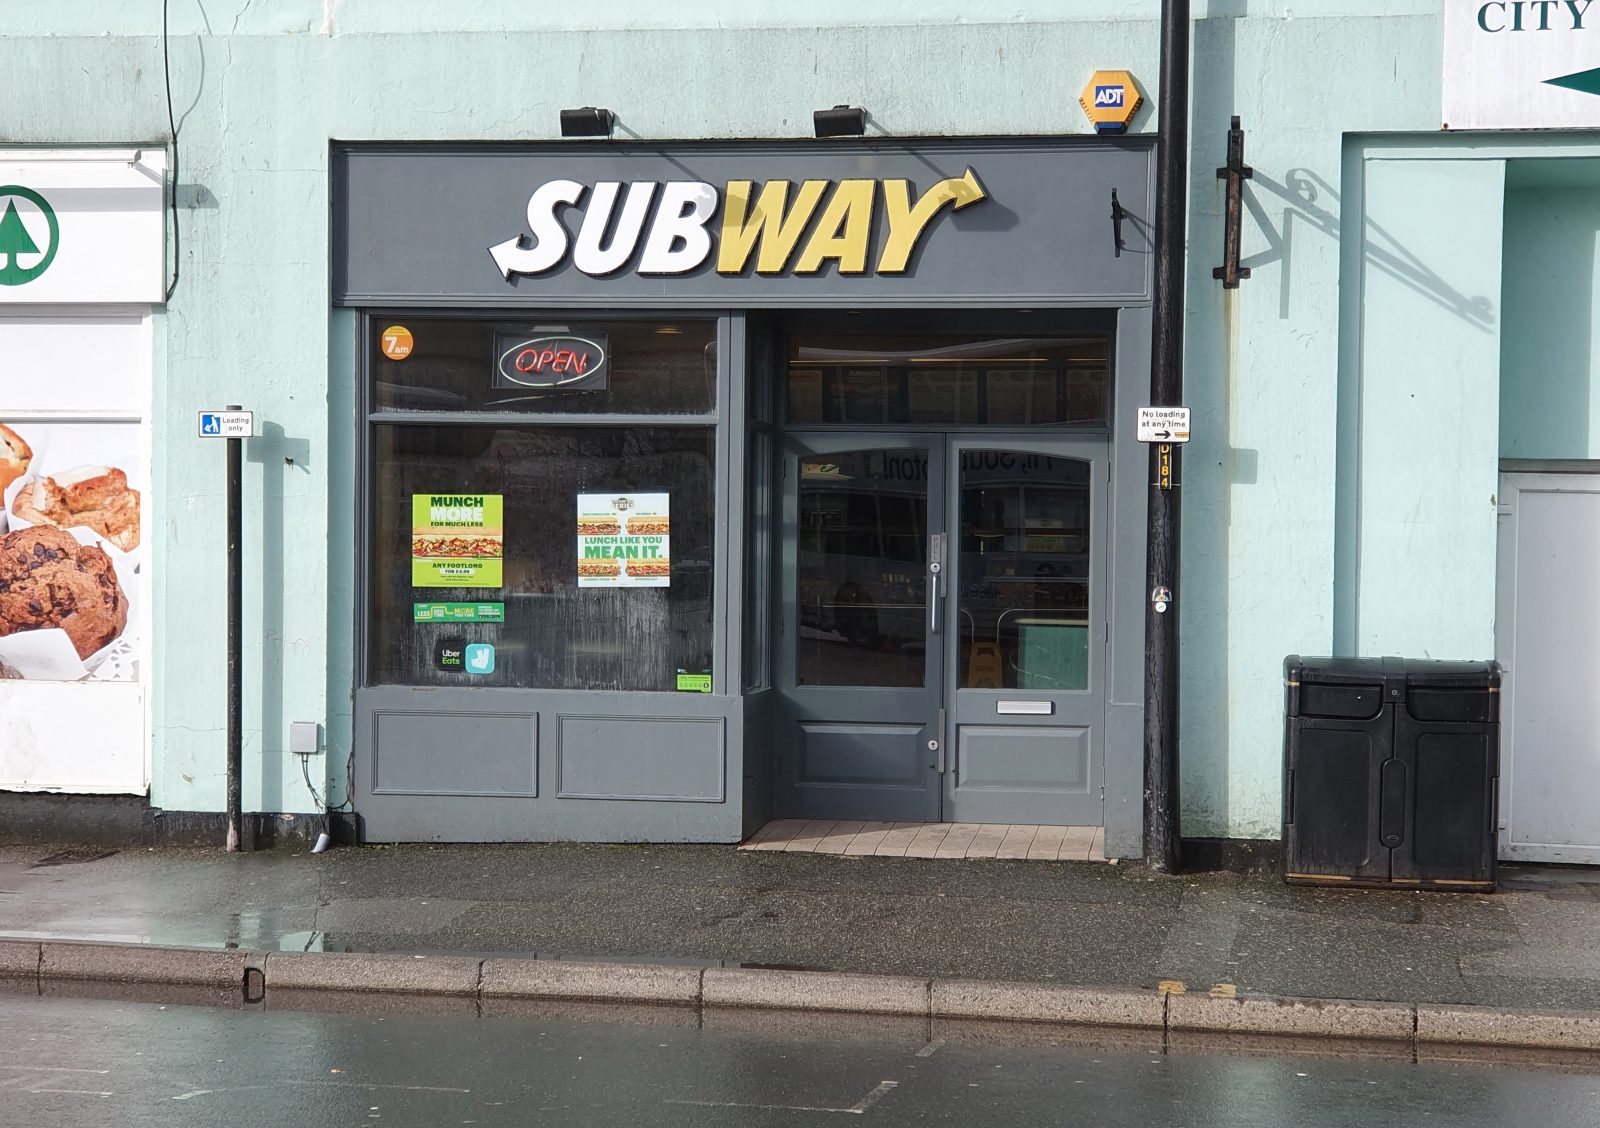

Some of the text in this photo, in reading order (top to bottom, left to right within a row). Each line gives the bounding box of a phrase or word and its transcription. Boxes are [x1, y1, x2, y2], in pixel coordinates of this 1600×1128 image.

[1478, 0, 1593, 33] CITY
[1095, 88, 1124, 104] ADT
[488, 165, 986, 283] SUBWAY
[385, 336, 409, 353] 7am
[515, 349, 587, 373] OPEN
[1142, 410, 1186, 419] No loading
[1161, 444, 1169, 487] D184
[430, 497, 484, 507] MUNCH
[430, 508, 484, 521] MORE
[584, 536, 663, 545] LUNCH LIKE YOU
[584, 545, 663, 559] MEAN IT.
[442, 649, 460, 657] Uber
[442, 657, 460, 665] Eats
